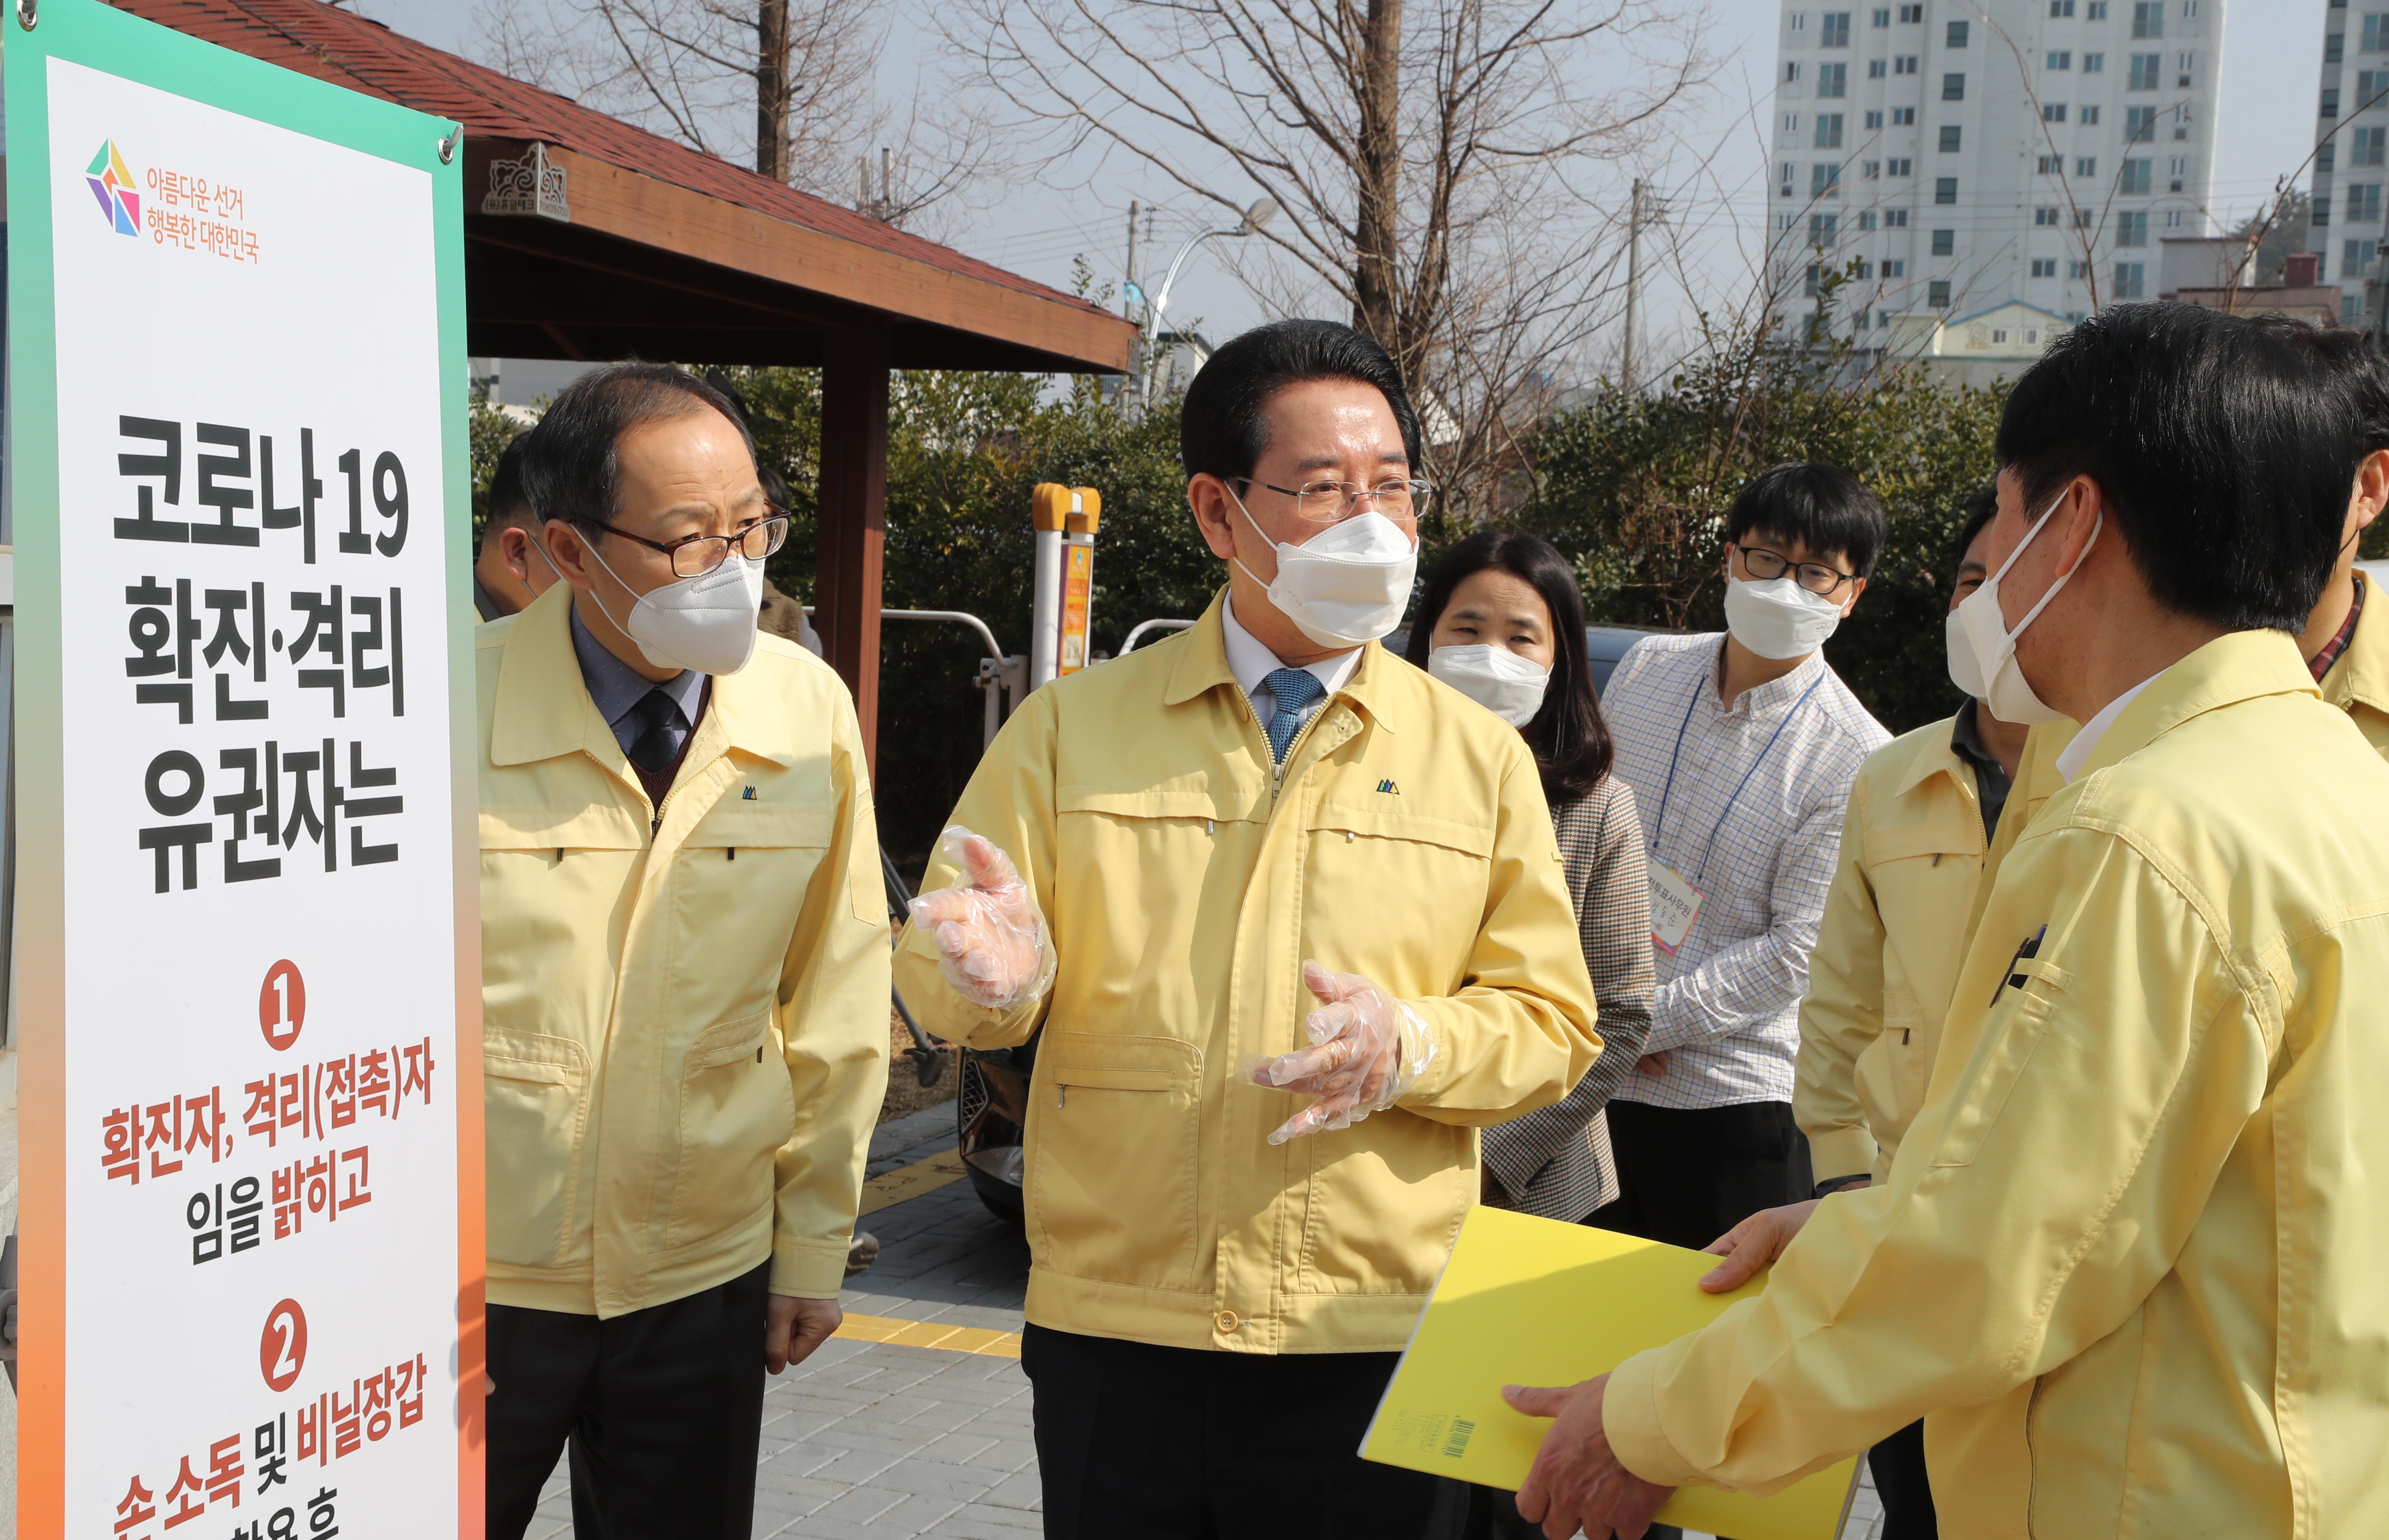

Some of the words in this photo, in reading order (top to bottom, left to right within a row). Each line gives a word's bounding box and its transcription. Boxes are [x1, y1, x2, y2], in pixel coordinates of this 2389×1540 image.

[147, 168, 210, 213] 아름다운
[213, 184, 243, 220] 선거
[147, 206, 197, 250] 행복한
[200, 221, 259, 264] 대한민국
[114, 415, 322, 564] 코로나
[339, 449, 408, 557] 19
[125, 576, 404, 724] 확진·격리
[139, 738, 403, 894] 유권자는
[101, 1086, 234, 1185] 확진자,
[243, 1036, 434, 1148] 격리(접촉)자
[187, 1176, 263, 1265] 임을
[272, 1145, 371, 1240] 밝히고
[164, 1433, 244, 1531] 소독
[255, 1412, 287, 1495] 및
[297, 1352, 427, 1468] 비닐장갑
